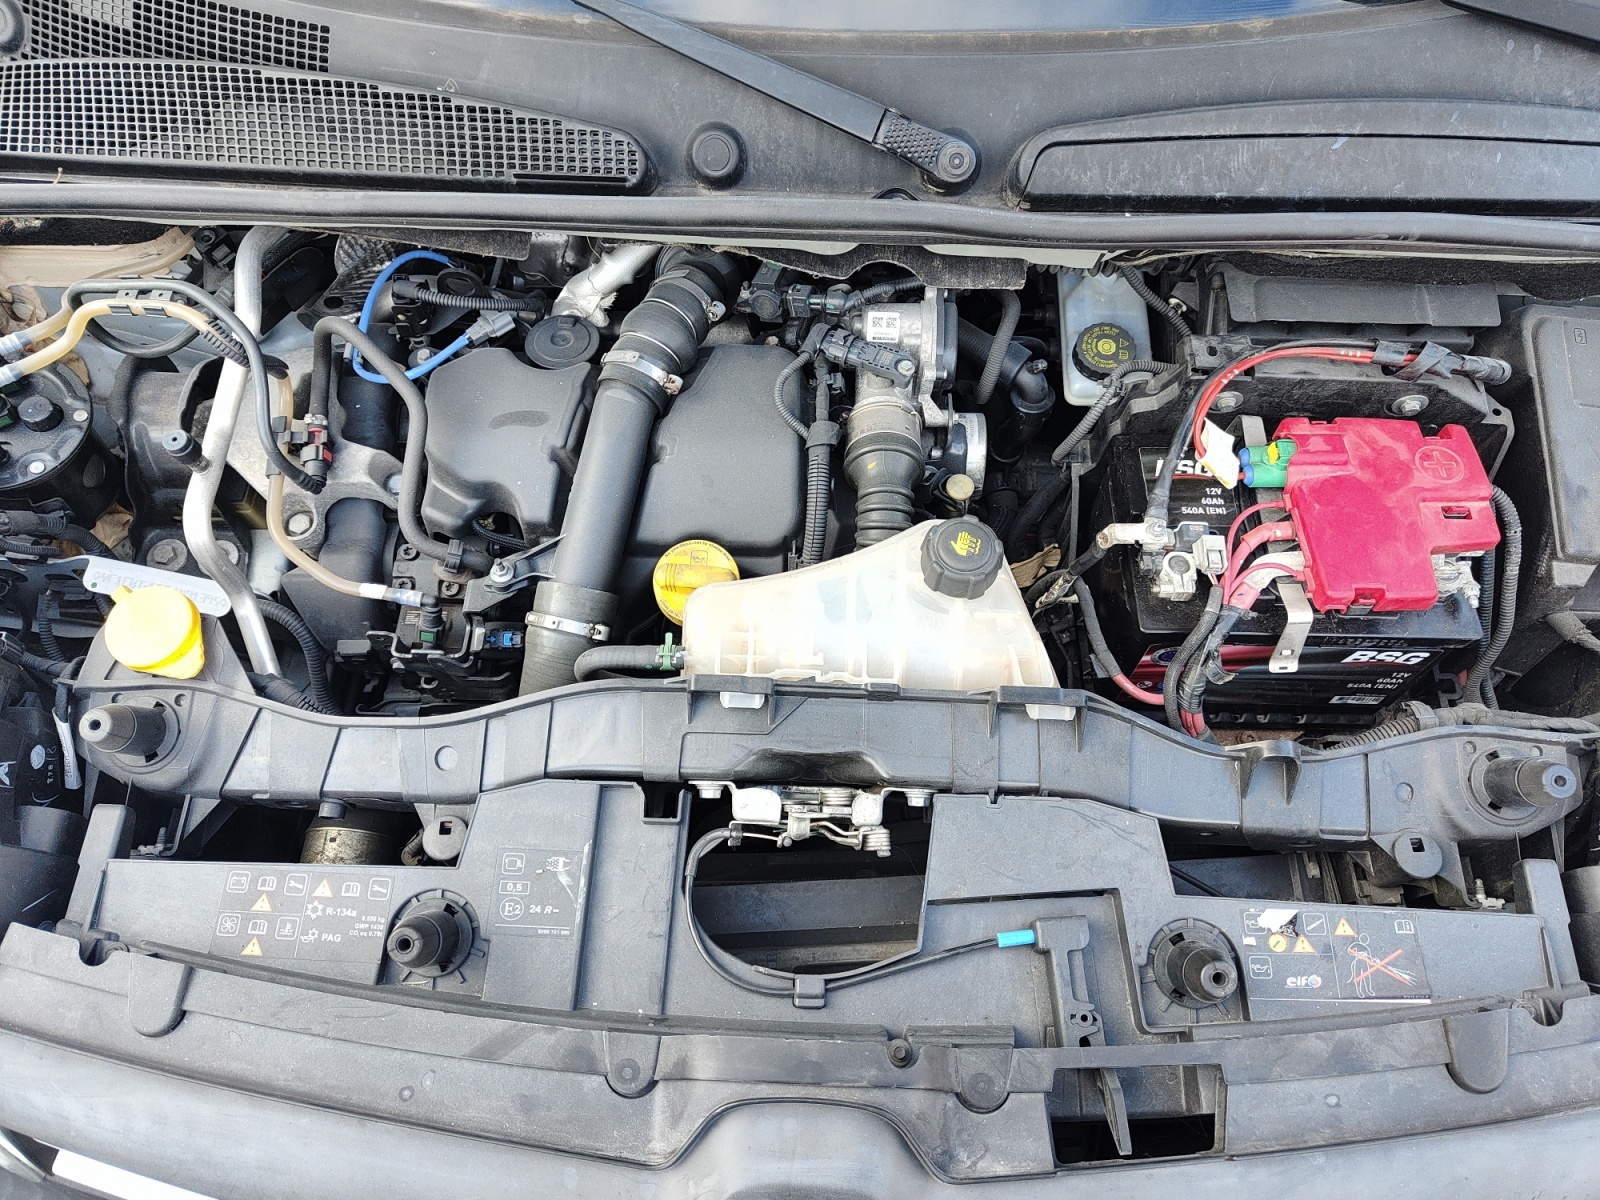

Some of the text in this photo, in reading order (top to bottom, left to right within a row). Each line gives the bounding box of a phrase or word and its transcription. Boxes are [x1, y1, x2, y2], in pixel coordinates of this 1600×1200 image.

[1201, 497, 1225, 505] 60Ah
[1341, 651, 1431, 665] BSG
[506, 882, 523, 892] 0,5
[325, 907, 357, 917] R-134a
[503, 902, 521, 916] E2
[529, 905, 541, 914] 24
[321, 933, 342, 942] PAG
[1286, 976, 1308, 986] elf
